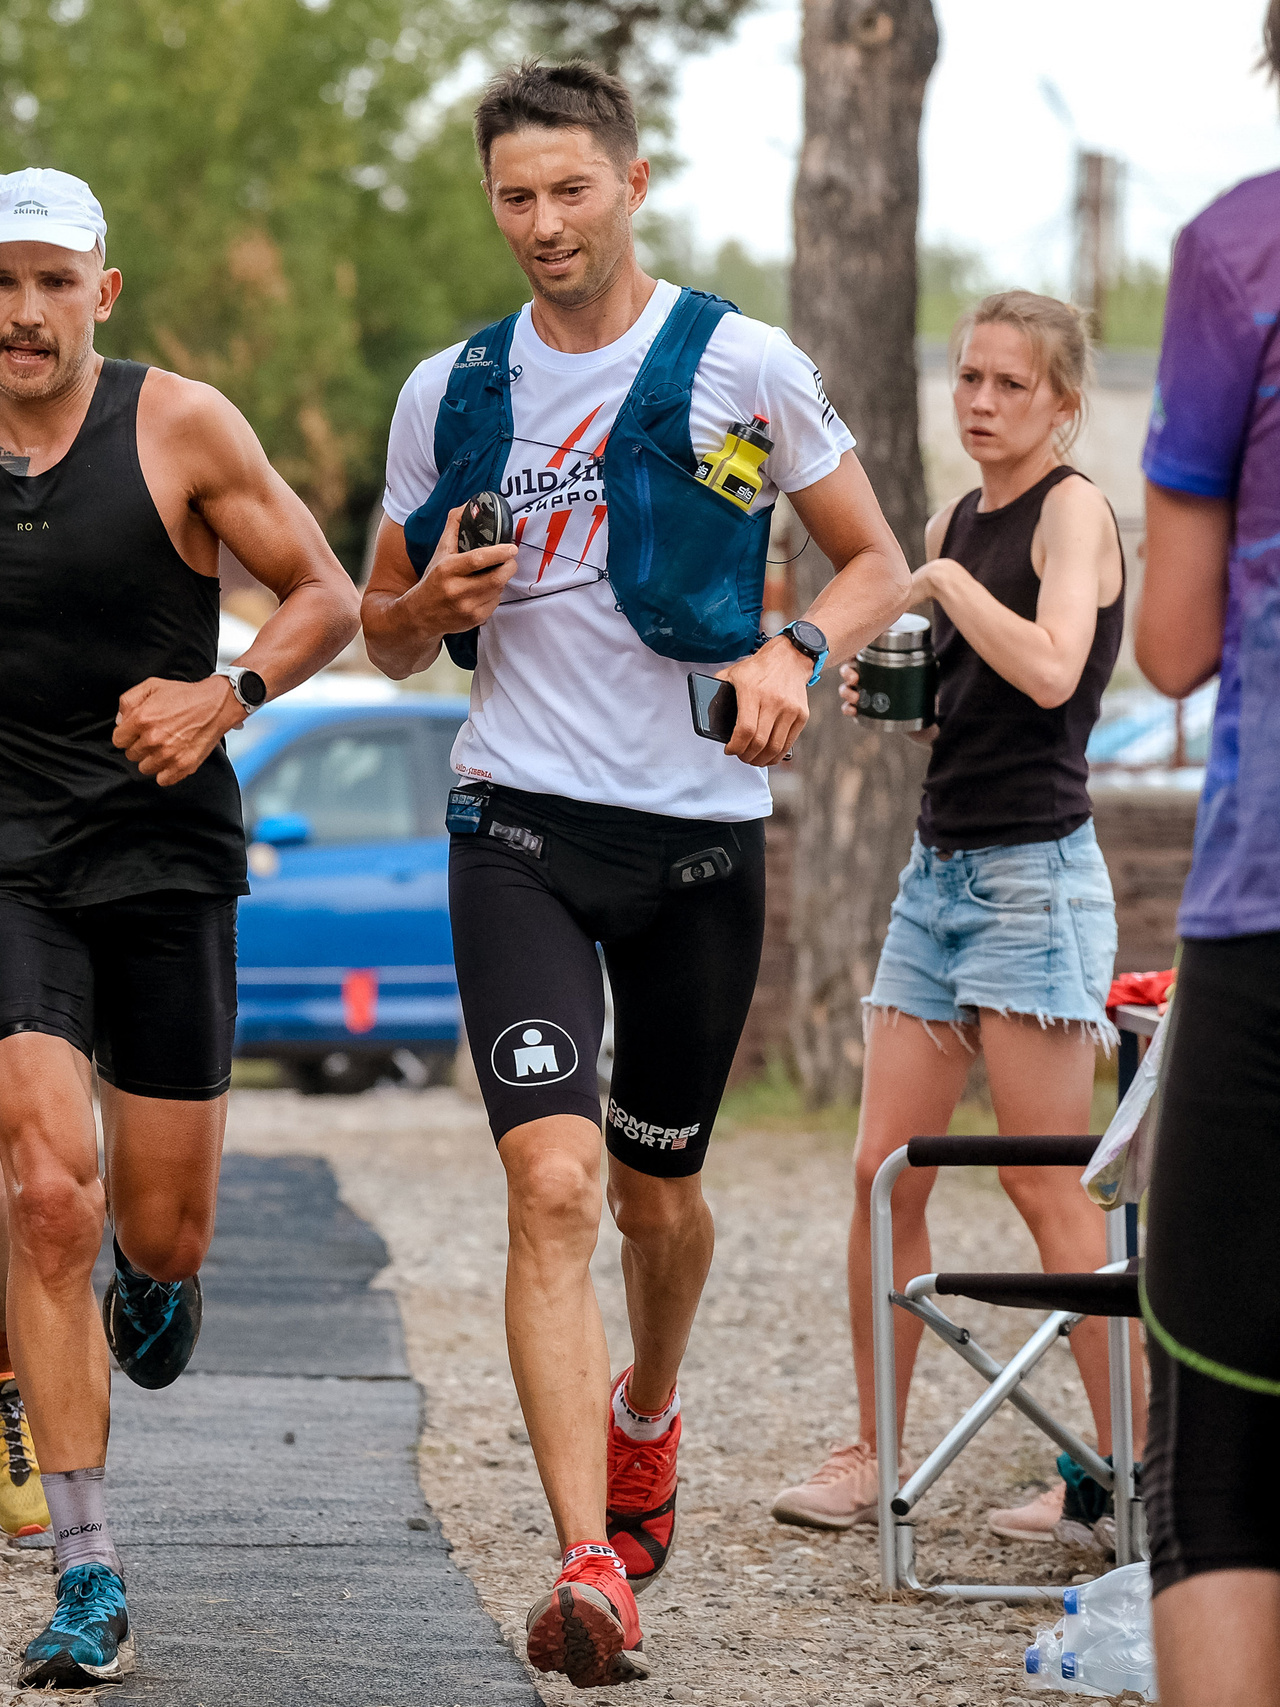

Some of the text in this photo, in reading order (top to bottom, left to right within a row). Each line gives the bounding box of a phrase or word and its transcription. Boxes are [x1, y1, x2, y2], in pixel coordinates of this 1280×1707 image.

[13, 208, 49, 217] skinfit
[524, 488, 607, 514] SUPPO
[59, 1522, 103, 1540] ROCKAY
